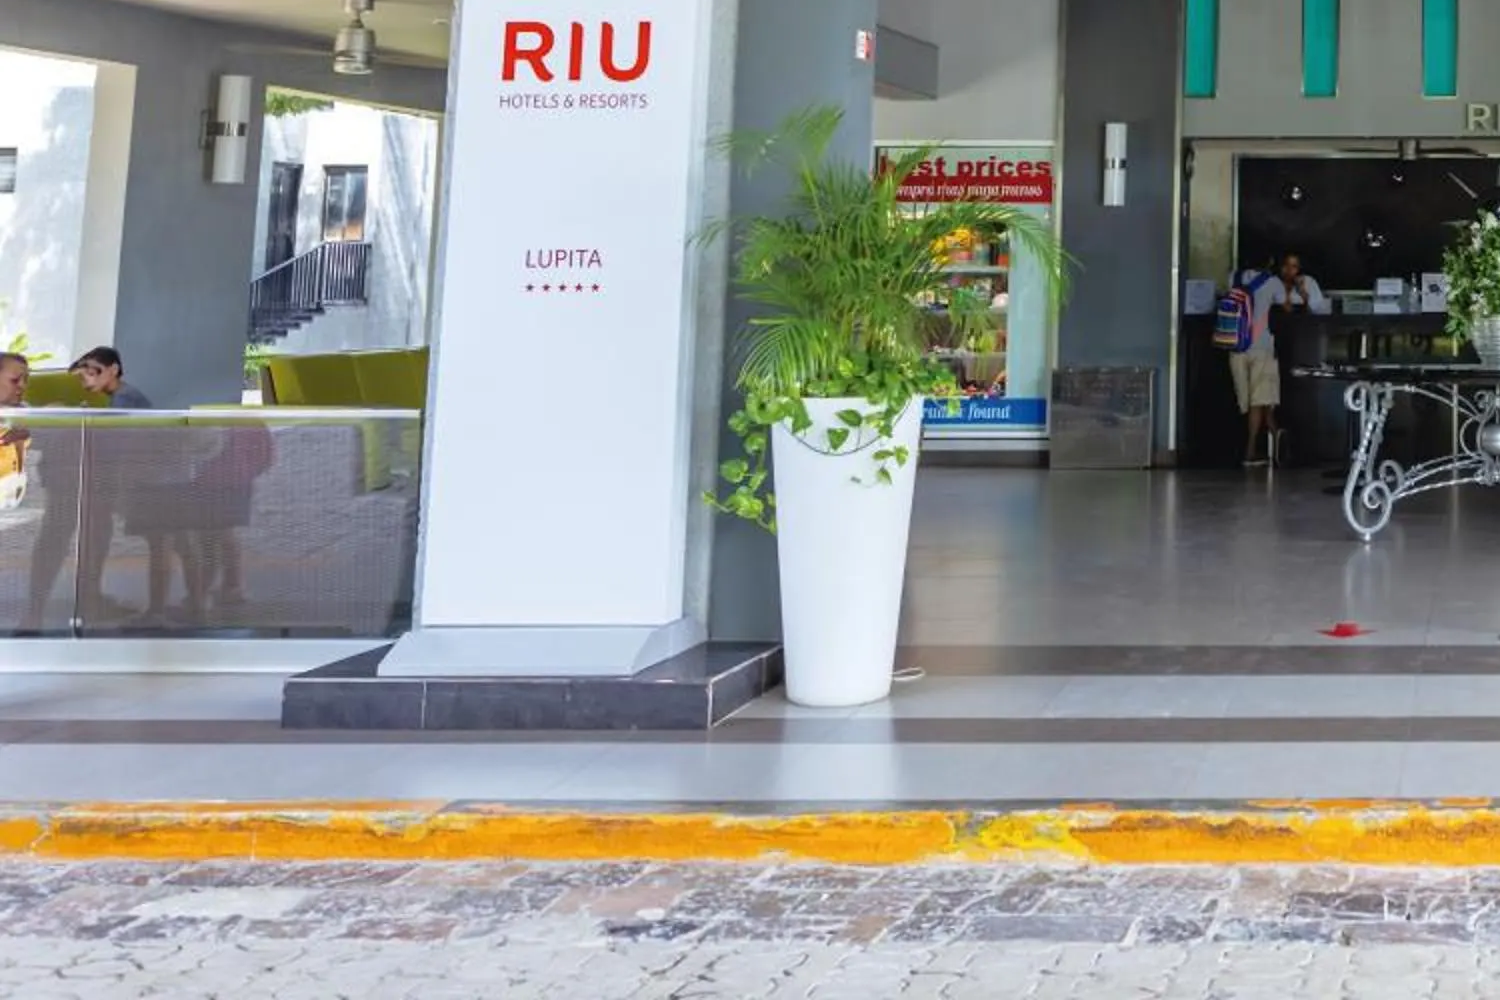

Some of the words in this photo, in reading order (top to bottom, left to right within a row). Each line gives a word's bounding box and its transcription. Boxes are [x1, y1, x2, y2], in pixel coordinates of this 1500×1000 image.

[502, 21, 652, 83] RIU
[500, 93, 560, 109] HOTELS
[563, 94, 575, 109] &
[579, 94, 650, 109] RESORTS
[956, 155, 1053, 178] prices
[525, 249, 602, 268] LUPITA
